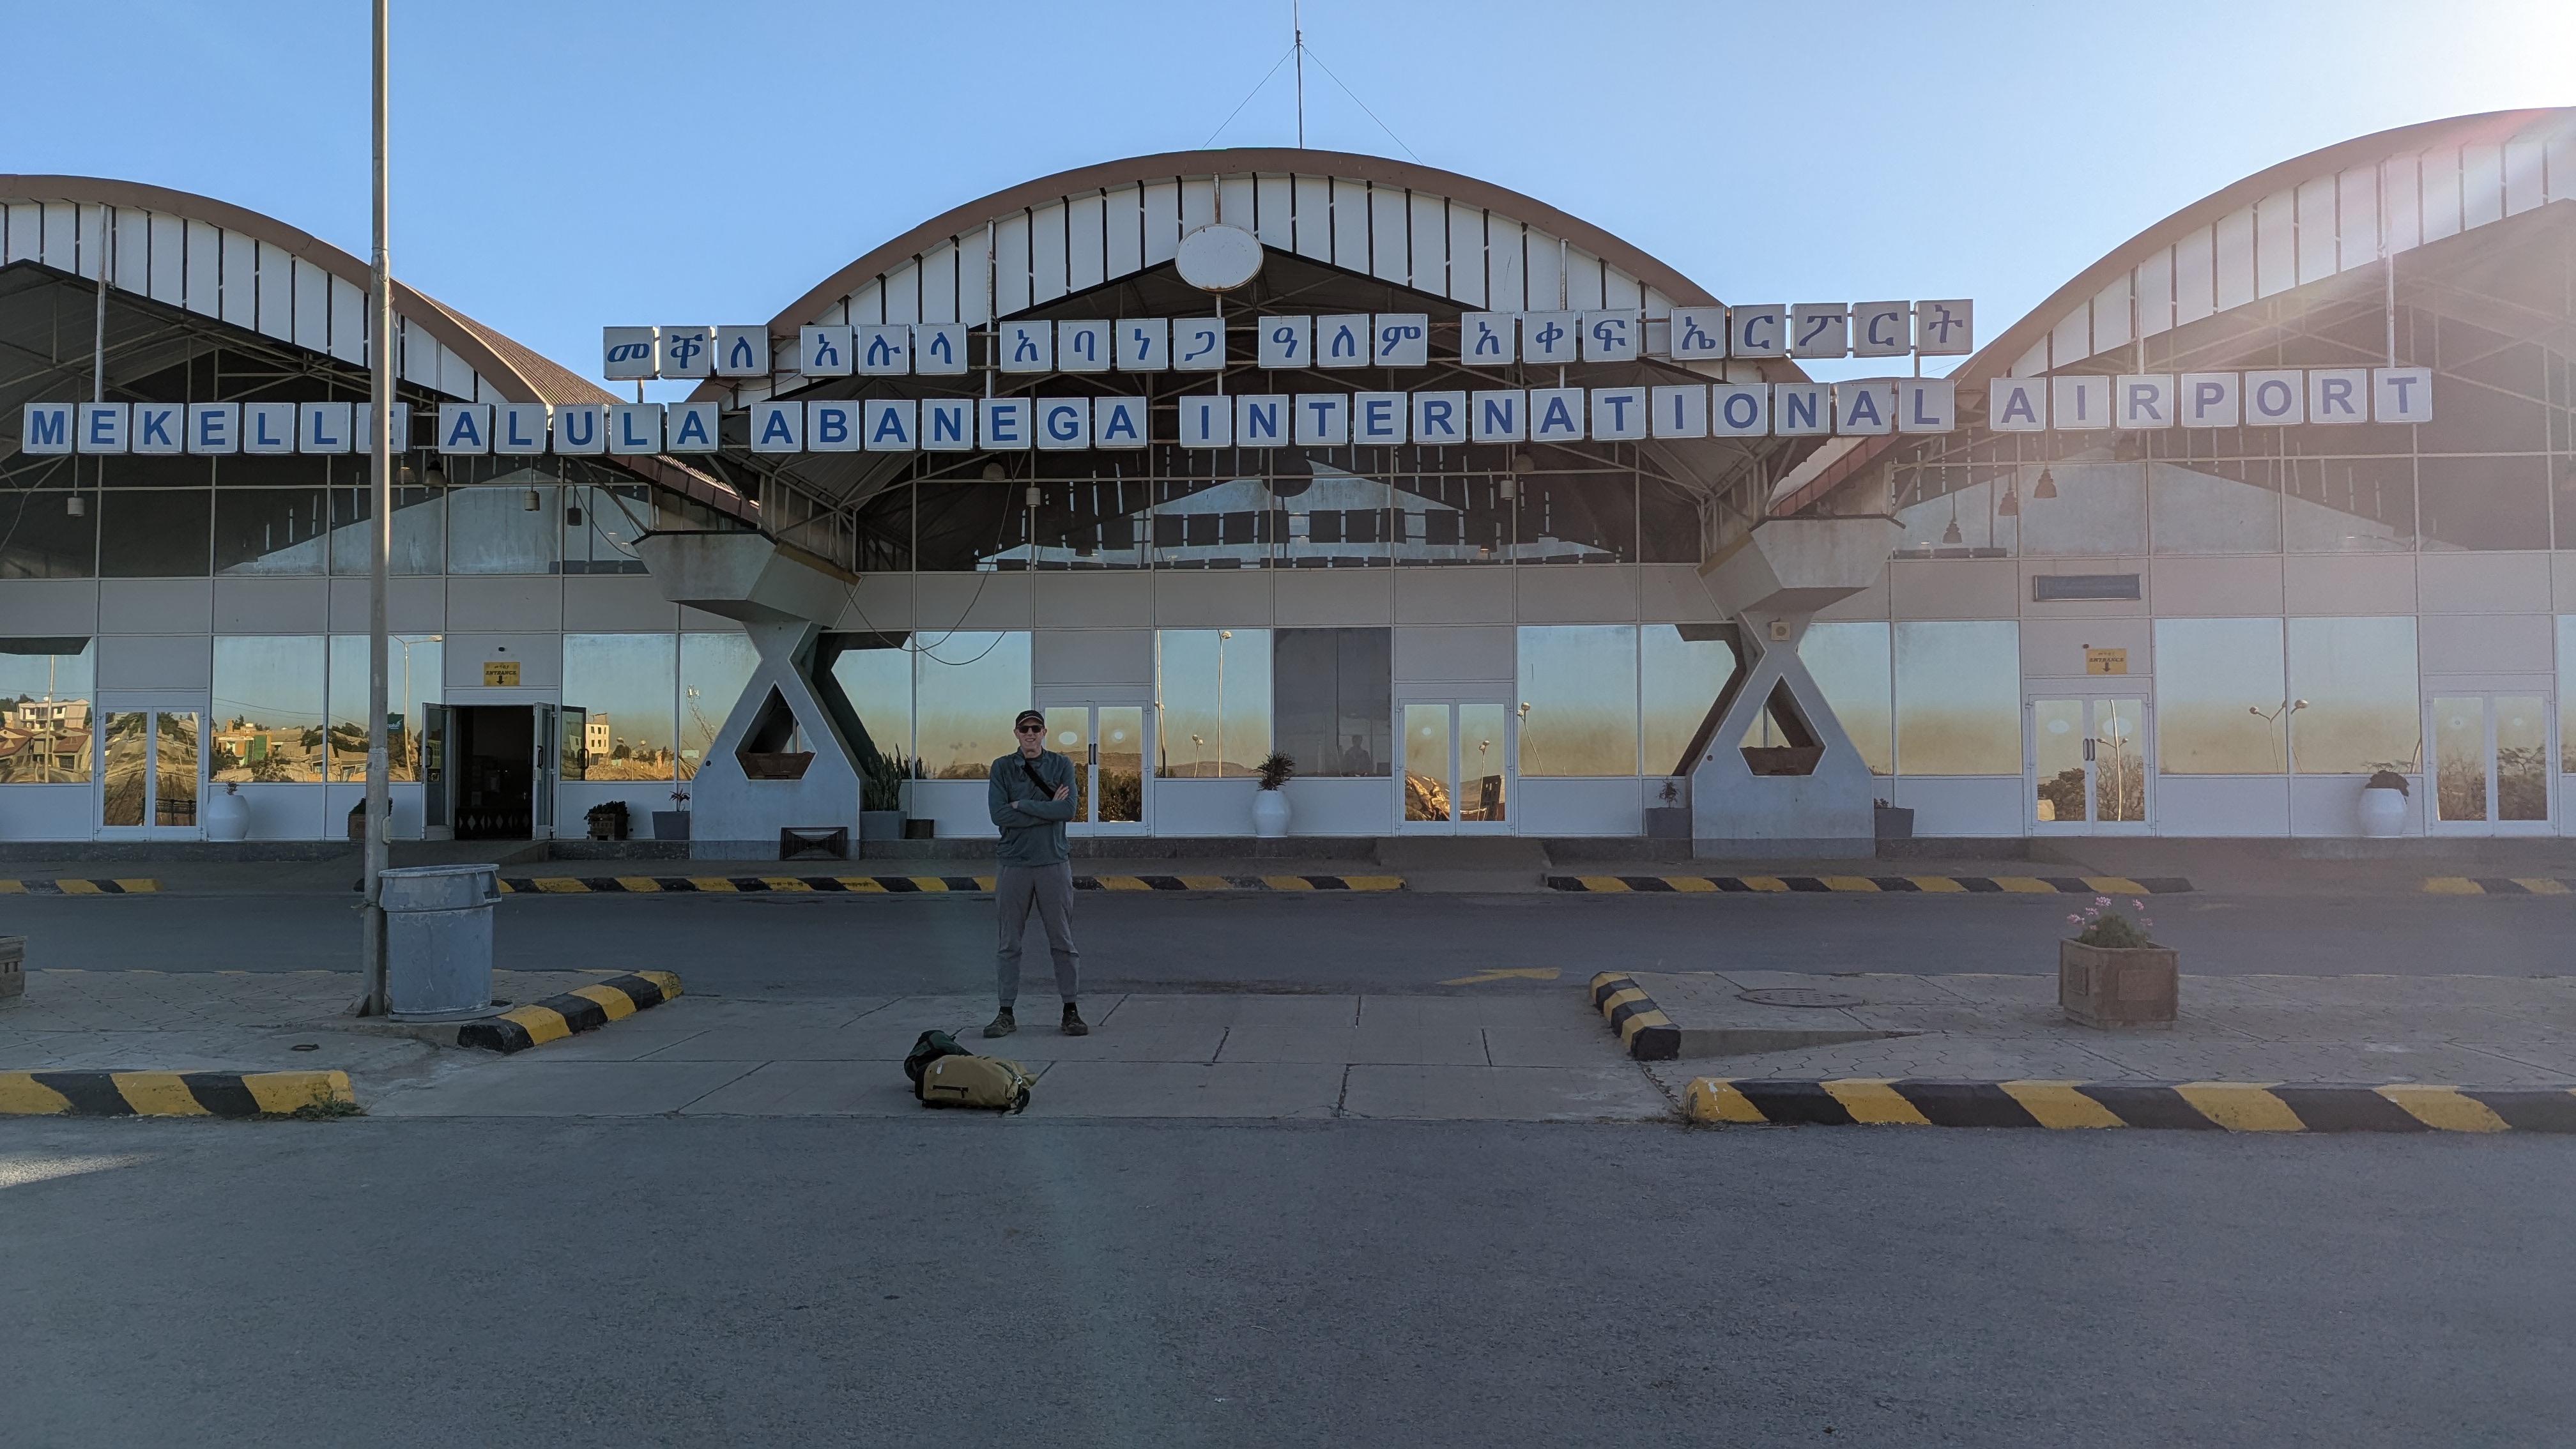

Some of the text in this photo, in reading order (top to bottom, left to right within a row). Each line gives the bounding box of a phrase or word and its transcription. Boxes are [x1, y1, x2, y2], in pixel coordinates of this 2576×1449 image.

[607, 304, 1963, 369] መቐለ አሉላ አባነጋ ዓለም አቀፍ ኤርፖርት
[447, 410, 709, 447] ALULA
[760, 404, 1137, 445] ABANEGA
[1200, 388, 1940, 440] INTERNATIONAL
[2001, 377, 2418, 424] AIRPORT
